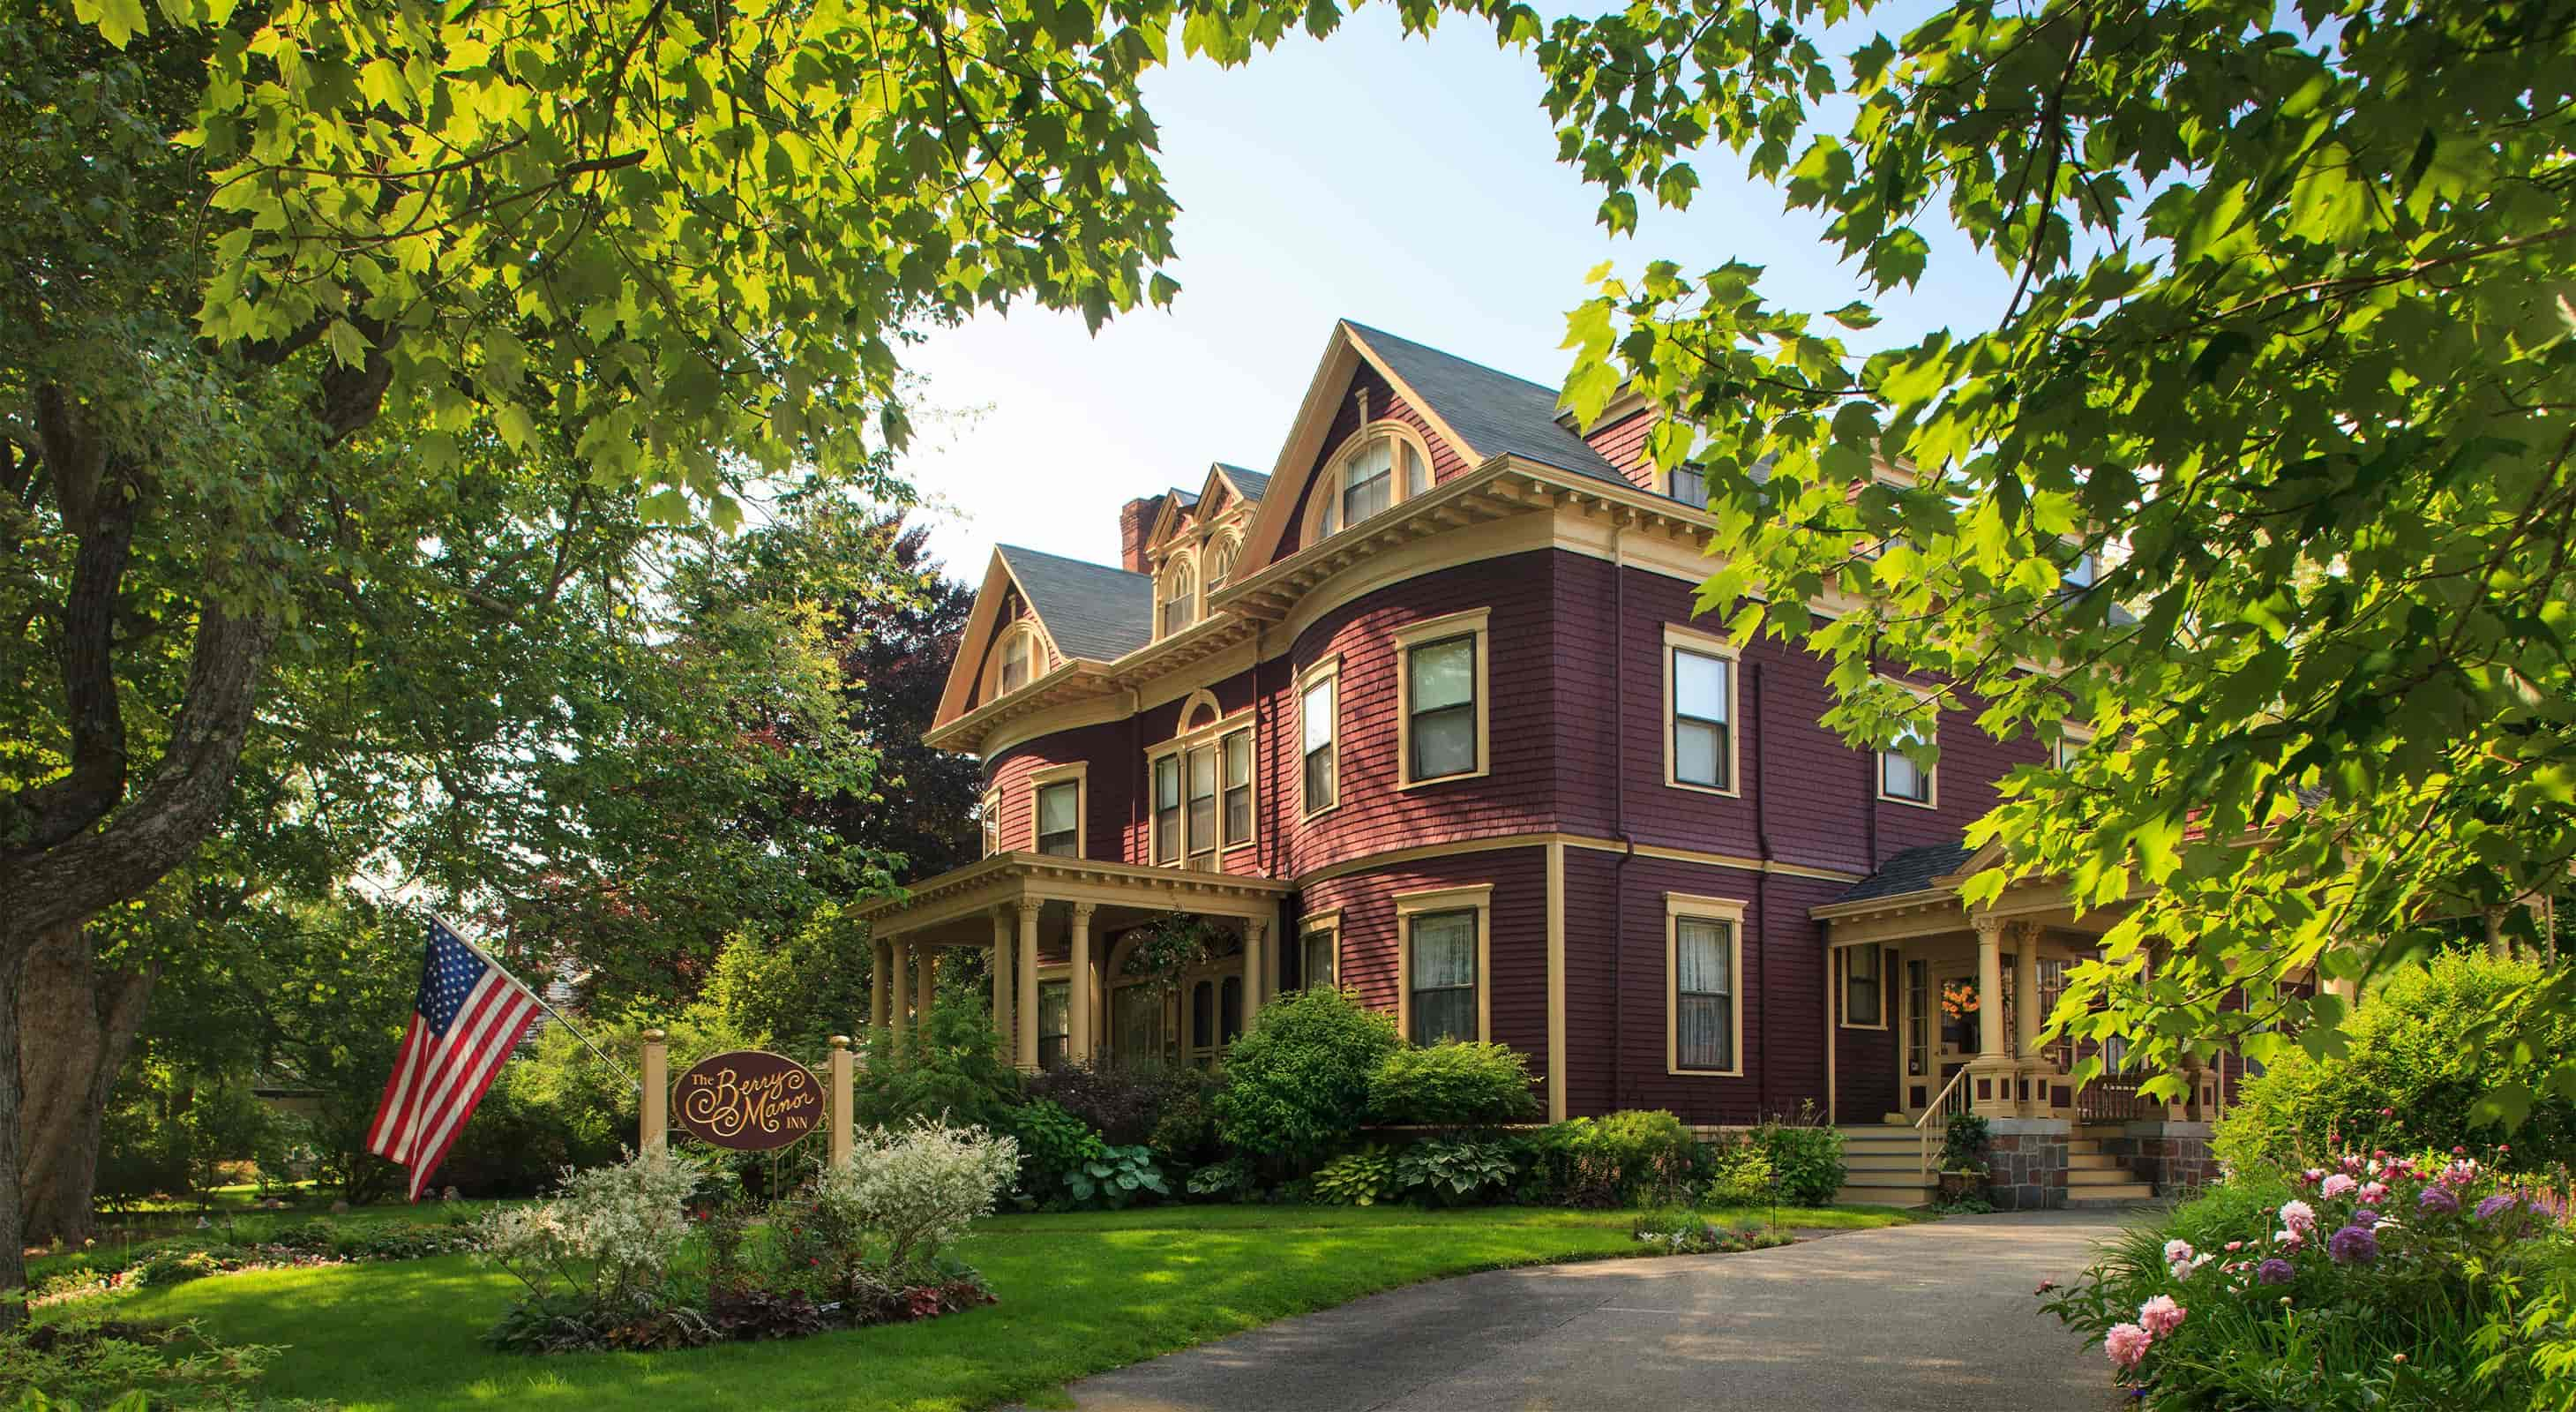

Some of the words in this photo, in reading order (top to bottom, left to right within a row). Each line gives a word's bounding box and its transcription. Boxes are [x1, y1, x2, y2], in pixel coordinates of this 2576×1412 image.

[691, 1073, 713, 1085] The
[685, 1067, 805, 1123] Berry
[711, 1089, 815, 1137] Manor
[786, 1115, 808, 1130] INN
